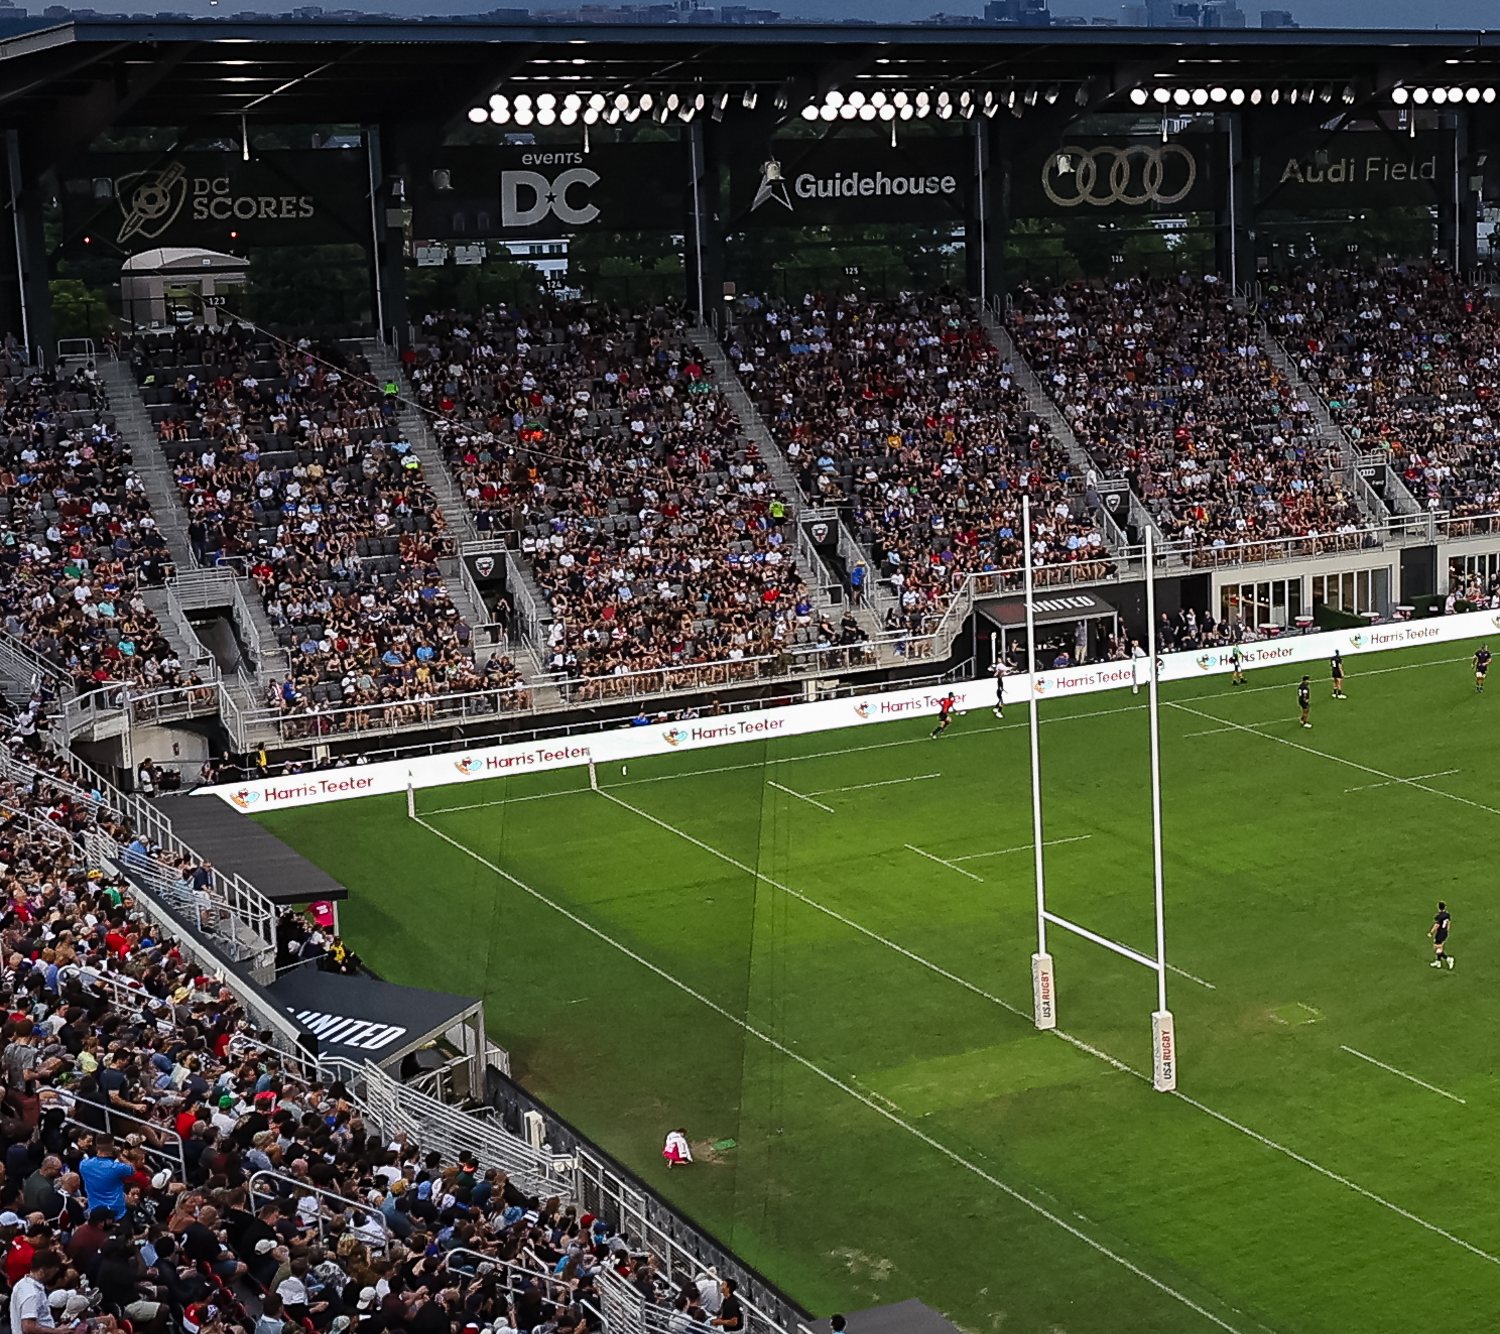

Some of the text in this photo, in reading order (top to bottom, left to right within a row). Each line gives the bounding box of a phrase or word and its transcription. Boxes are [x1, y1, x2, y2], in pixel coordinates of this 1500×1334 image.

[522, 151, 583, 166] events
[1280, 155, 1436, 184] Audi Field
[194, 178, 230, 195] DC
[795, 172, 957, 200] Guidehouse
[501, 169, 601, 227] DC
[194, 196, 315, 220] SCORES
[845, 267, 858, 275] 125
[547, 280, 562, 289] 124
[208, 297, 225, 307] 123
[1371, 628, 1438, 644] Harris Teeter
[1257, 648, 1293, 660] Teeter
[1057, 676, 1092, 688] Harris
[881, 700, 921, 713] Harris
[692, 719, 784, 740] Harris Teeter
[487, 747, 589, 769] Harris Teeter
[265, 777, 373, 801] Harris Teeter
[1041, 971, 1050, 1000] RUGBY
[1161, 1030, 1171, 1080] USA RUGBY
